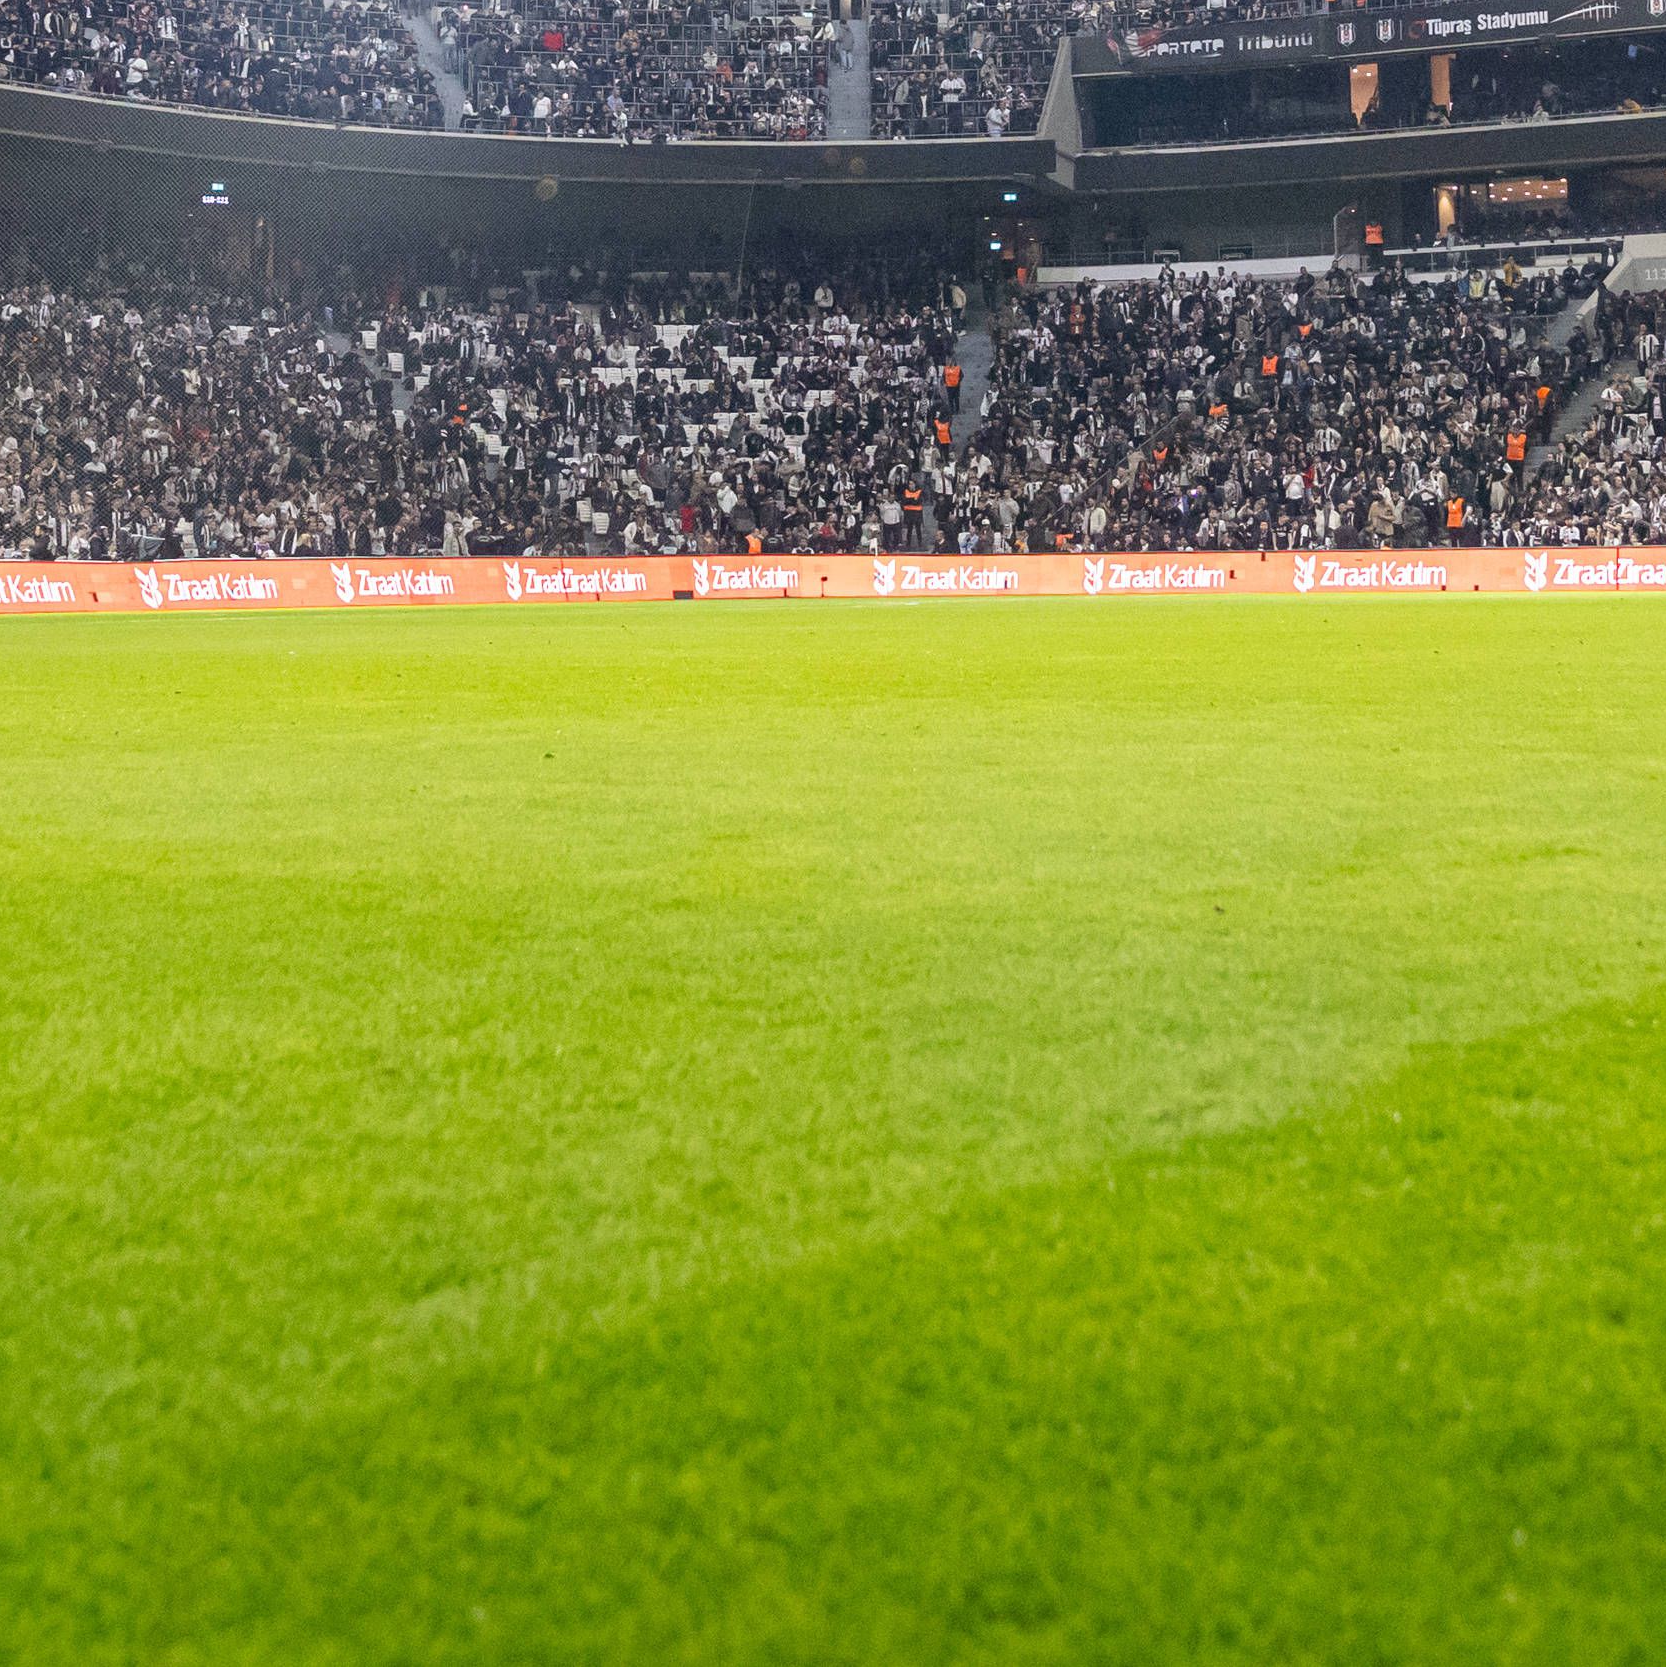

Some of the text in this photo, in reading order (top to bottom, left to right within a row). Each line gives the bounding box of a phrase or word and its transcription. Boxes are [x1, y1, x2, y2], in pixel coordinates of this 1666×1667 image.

[1425, 10, 1549, 38] Tüpraş Stadyumu
[355, 569, 454, 596] Ziraat Katılım
[523, 568, 647, 594] Ziraat Ziraat Katılım
[711, 565, 799, 590] Ziraat Katılım
[900, 565, 1019, 590] Ziraat Katılım
[1108, 563, 1225, 589] Ziraat Katılım
[1319, 561, 1447, 588] Ziraat Katılım
[1553, 558, 1617, 585] Ziraat
[6, 574, 76, 603] Katılım
[162, 573, 278, 602] Ziraat Katılım
